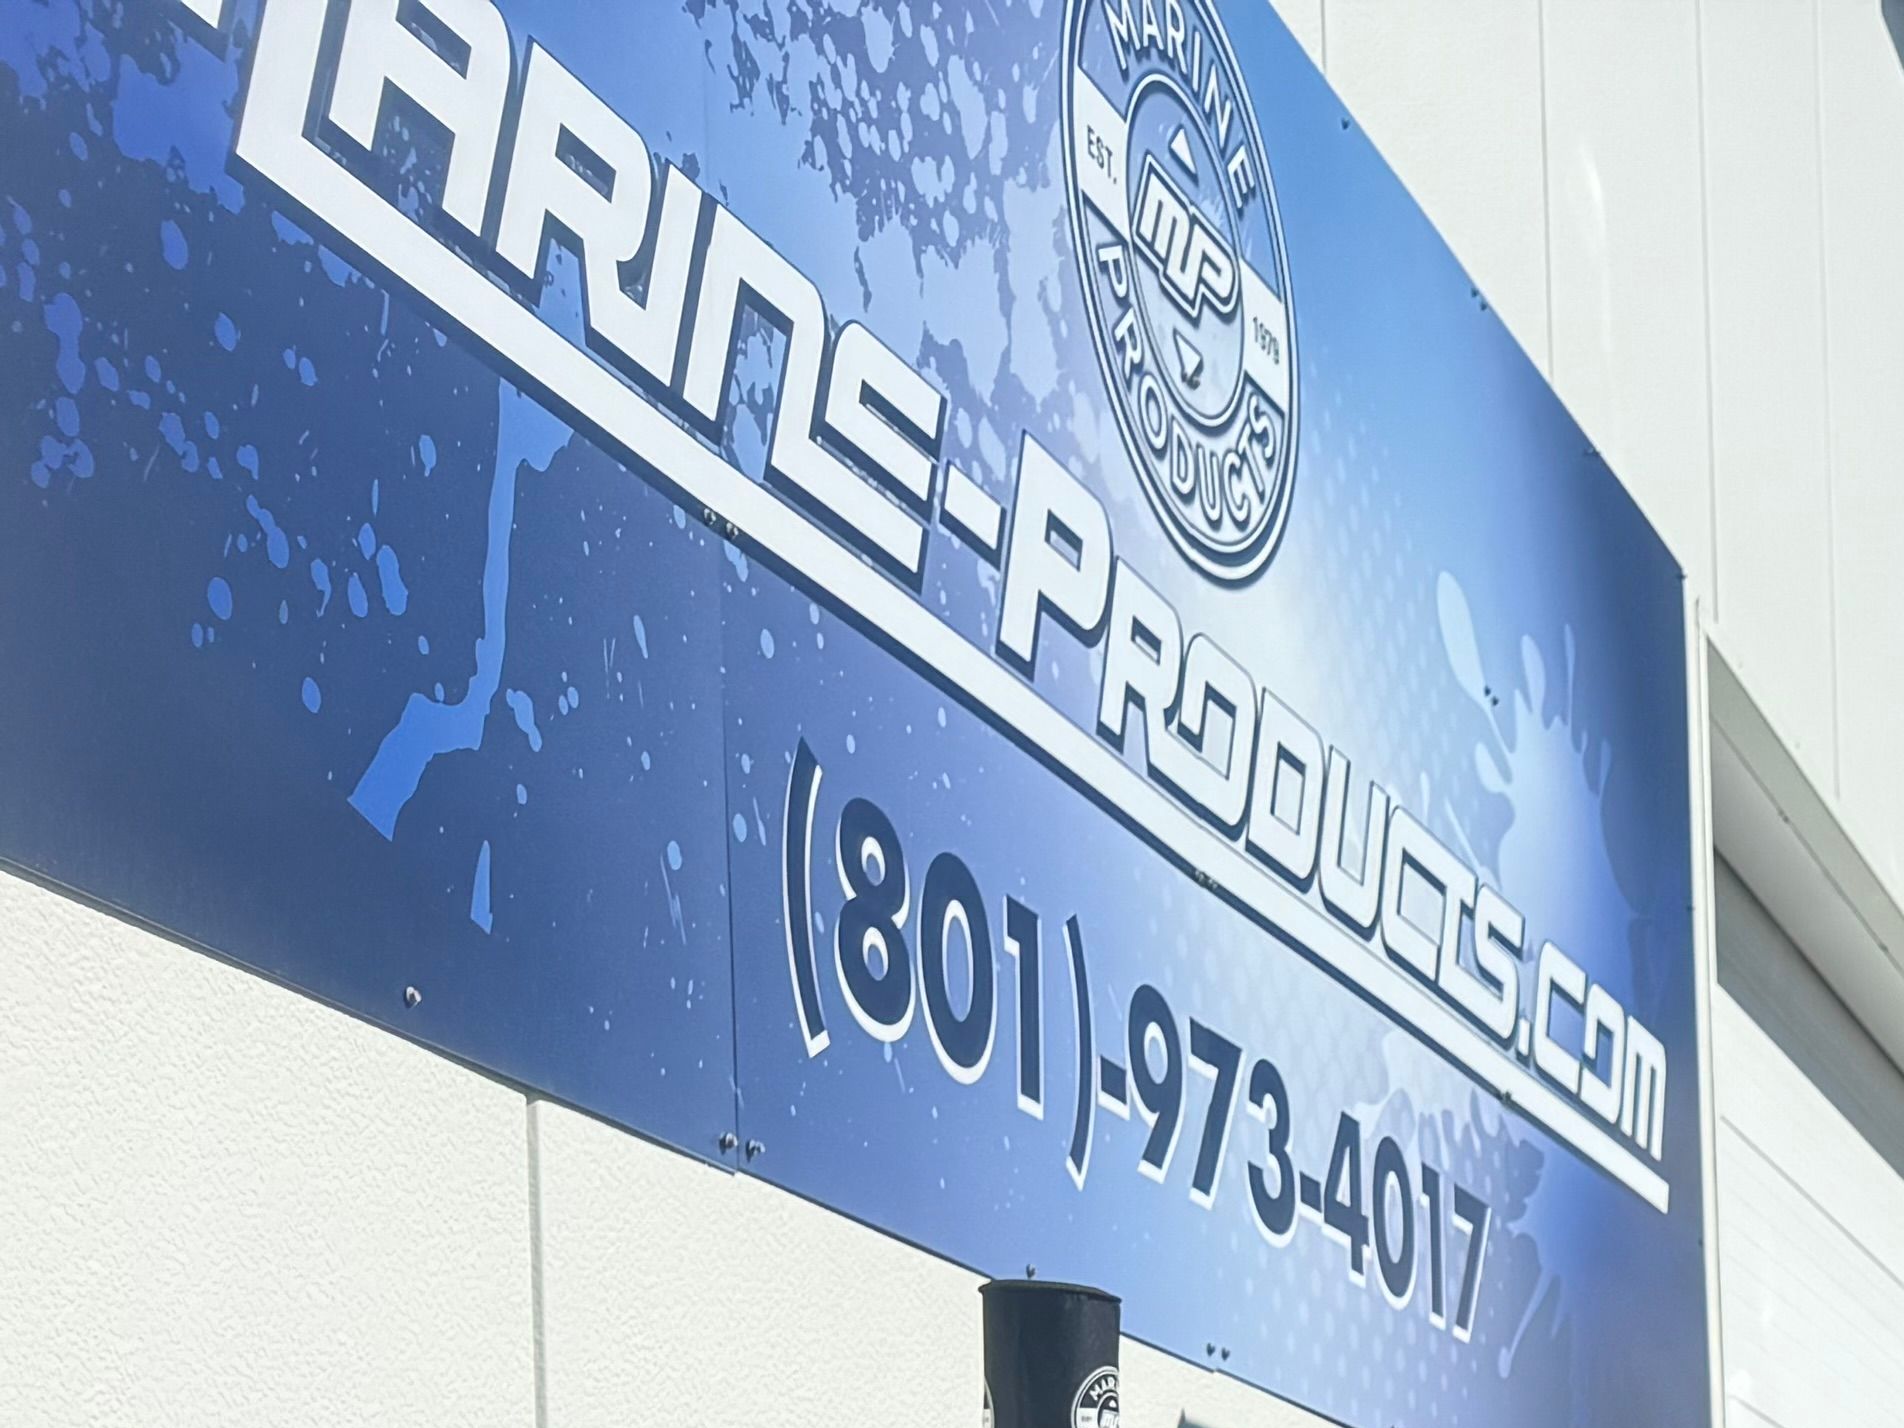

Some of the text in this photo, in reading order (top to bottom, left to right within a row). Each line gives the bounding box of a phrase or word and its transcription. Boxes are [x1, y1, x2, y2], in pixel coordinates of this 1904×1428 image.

[1086, 125, 1118, 185] EST.
[1104, 0, 1255, 209] MARINE
[1097, 244, 1278, 522] PRODUCTS
[782, 737, 1492, 1343] (801)-973-4017
